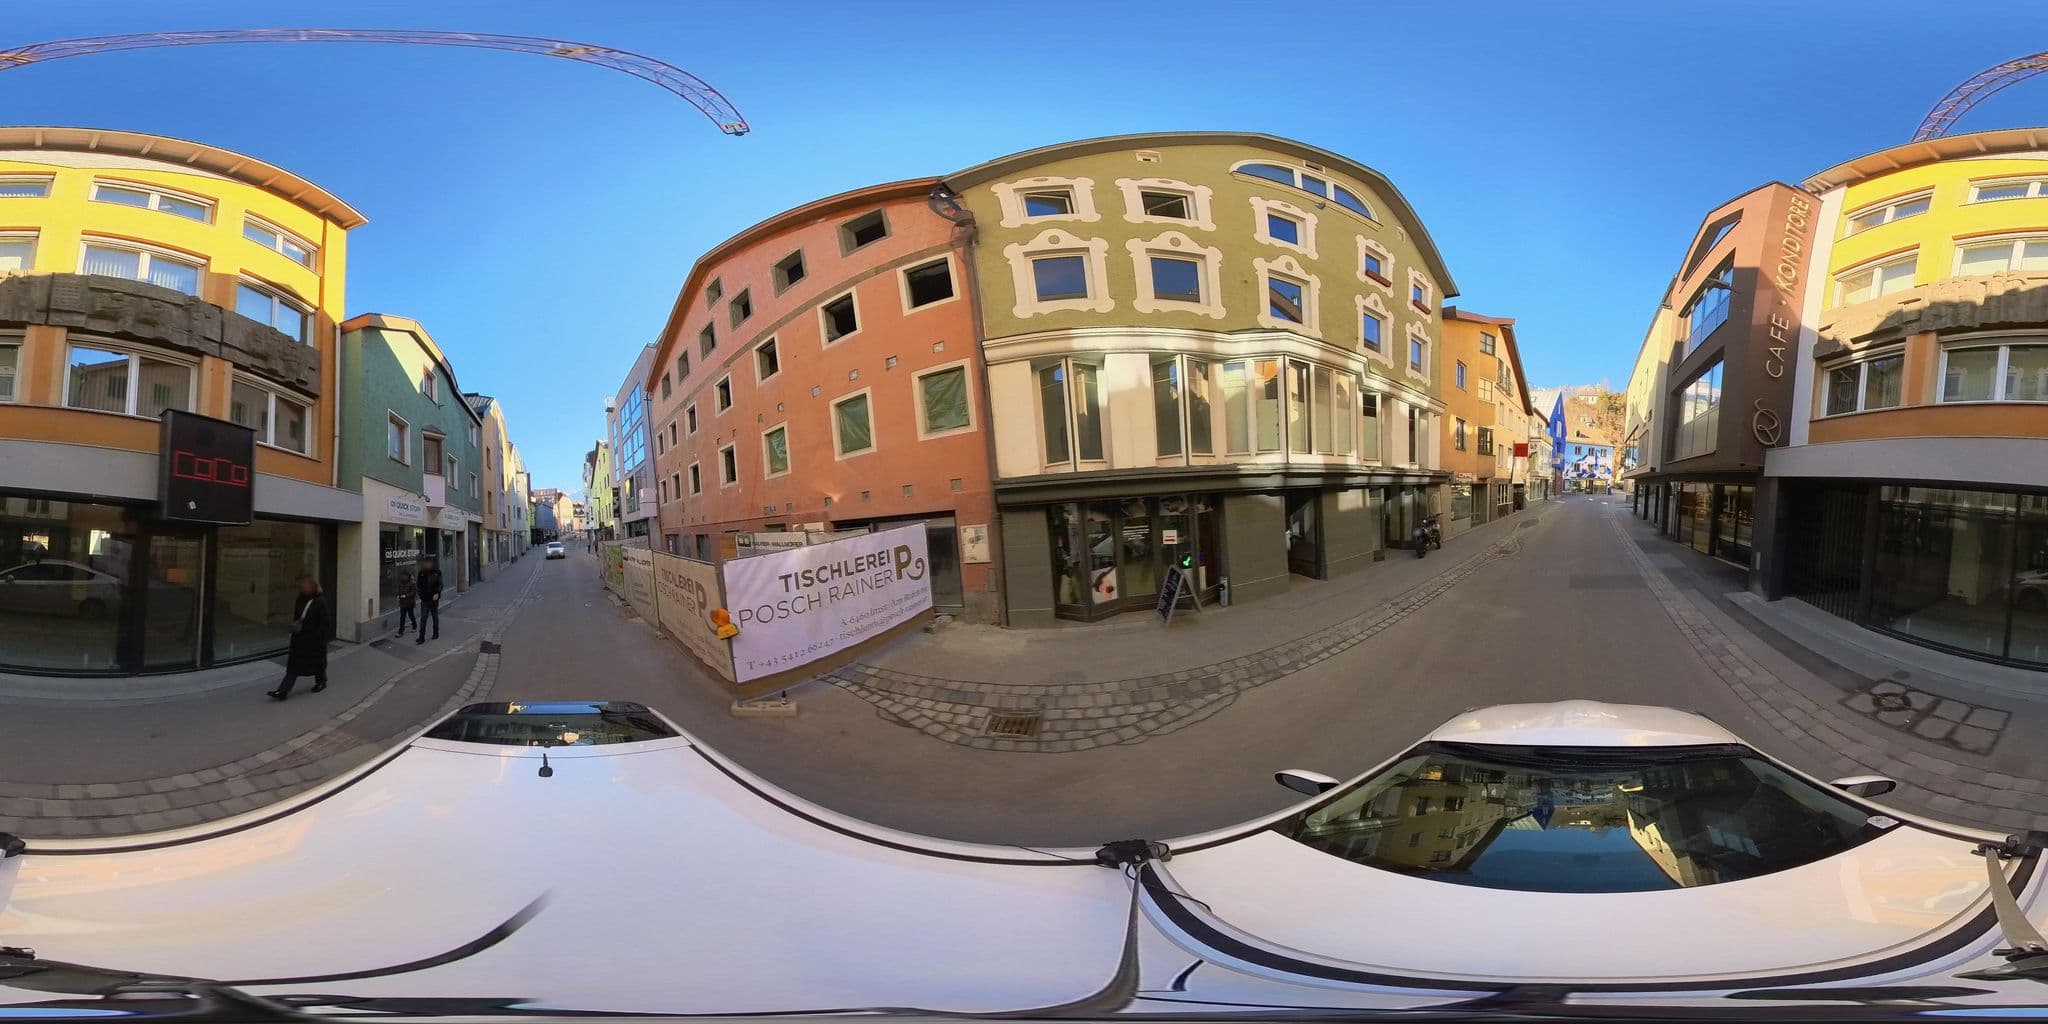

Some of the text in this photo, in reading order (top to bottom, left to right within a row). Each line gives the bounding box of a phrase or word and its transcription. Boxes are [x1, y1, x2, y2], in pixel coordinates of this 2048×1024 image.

[1766, 313, 1790, 379] CAFE
[738, 591, 822, 629] POSCH
[829, 569, 894, 604] RAINER
[778, 549, 891, 593] TISCHLEREI
